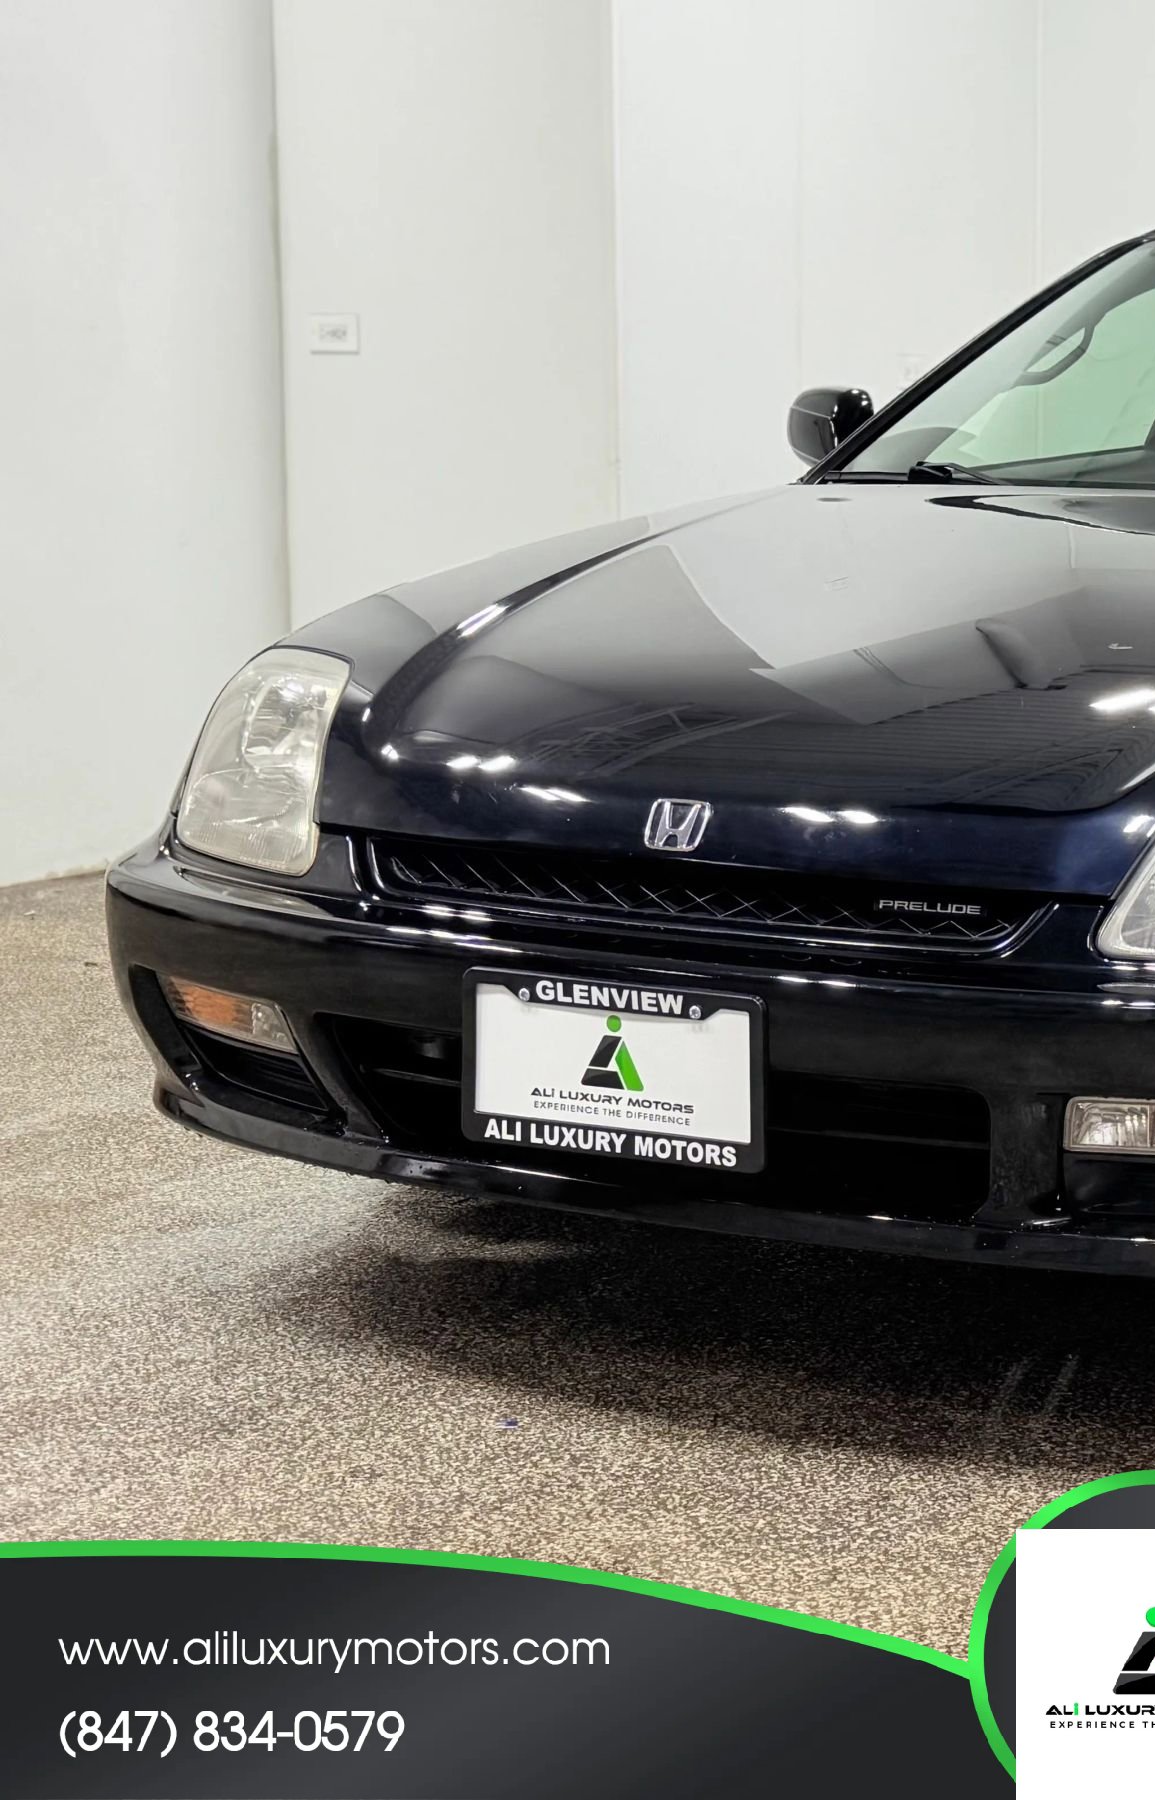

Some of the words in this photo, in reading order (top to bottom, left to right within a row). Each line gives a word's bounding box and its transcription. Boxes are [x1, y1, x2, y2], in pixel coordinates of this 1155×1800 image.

[878, 899, 982, 915] PRELUDE
[535, 979, 684, 1015] GLENVIEW
[533, 1100, 600, 1115] EXPERIENCE
[602, 1107, 622, 1118] THE
[625, 1110, 692, 1127] DIFFERENCE
[559, 1089, 623, 1106] LUXURY
[626, 1097, 695, 1115] MOTORS
[484, 1118, 522, 1141] ALI
[530, 1123, 628, 1154] LUXURY
[634, 1137, 737, 1168] MOTORS
